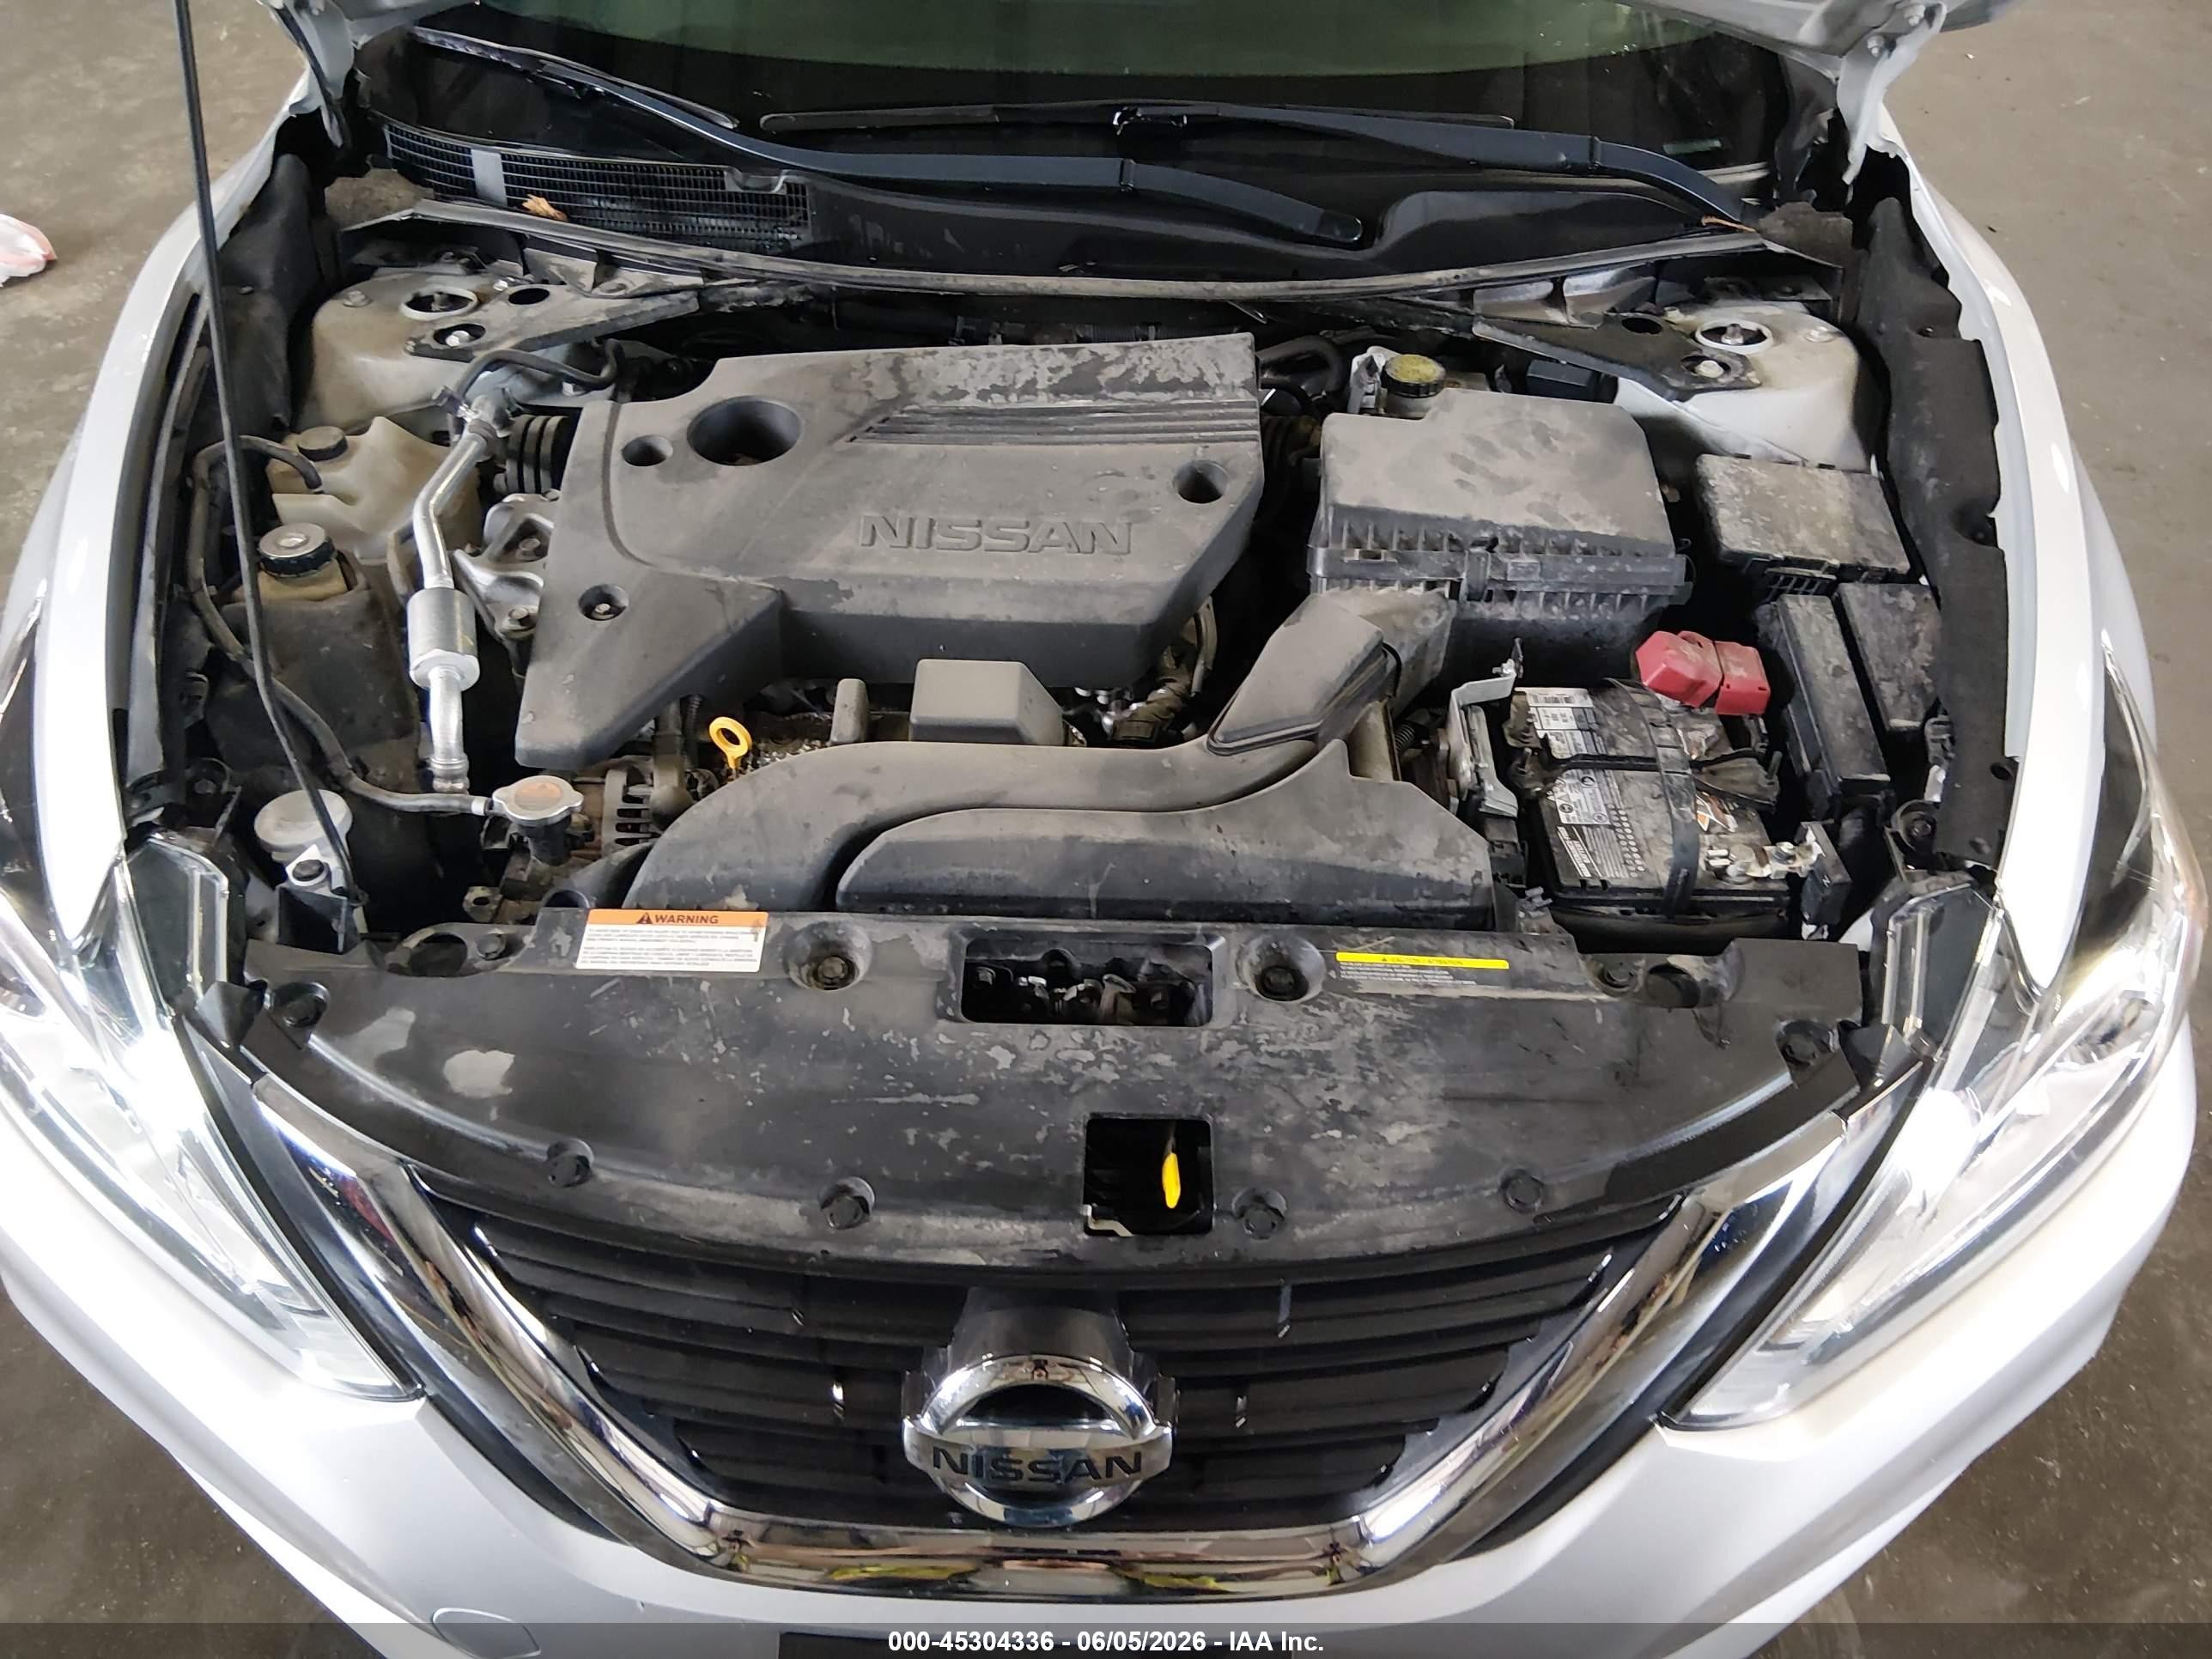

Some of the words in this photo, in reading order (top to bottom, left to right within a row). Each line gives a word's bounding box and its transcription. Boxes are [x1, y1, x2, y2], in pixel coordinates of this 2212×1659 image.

[860, 515, 1131, 556] NISSAN
[654, 914, 720, 925] WARNING
[933, 1447, 1142, 1485] NISSAN
